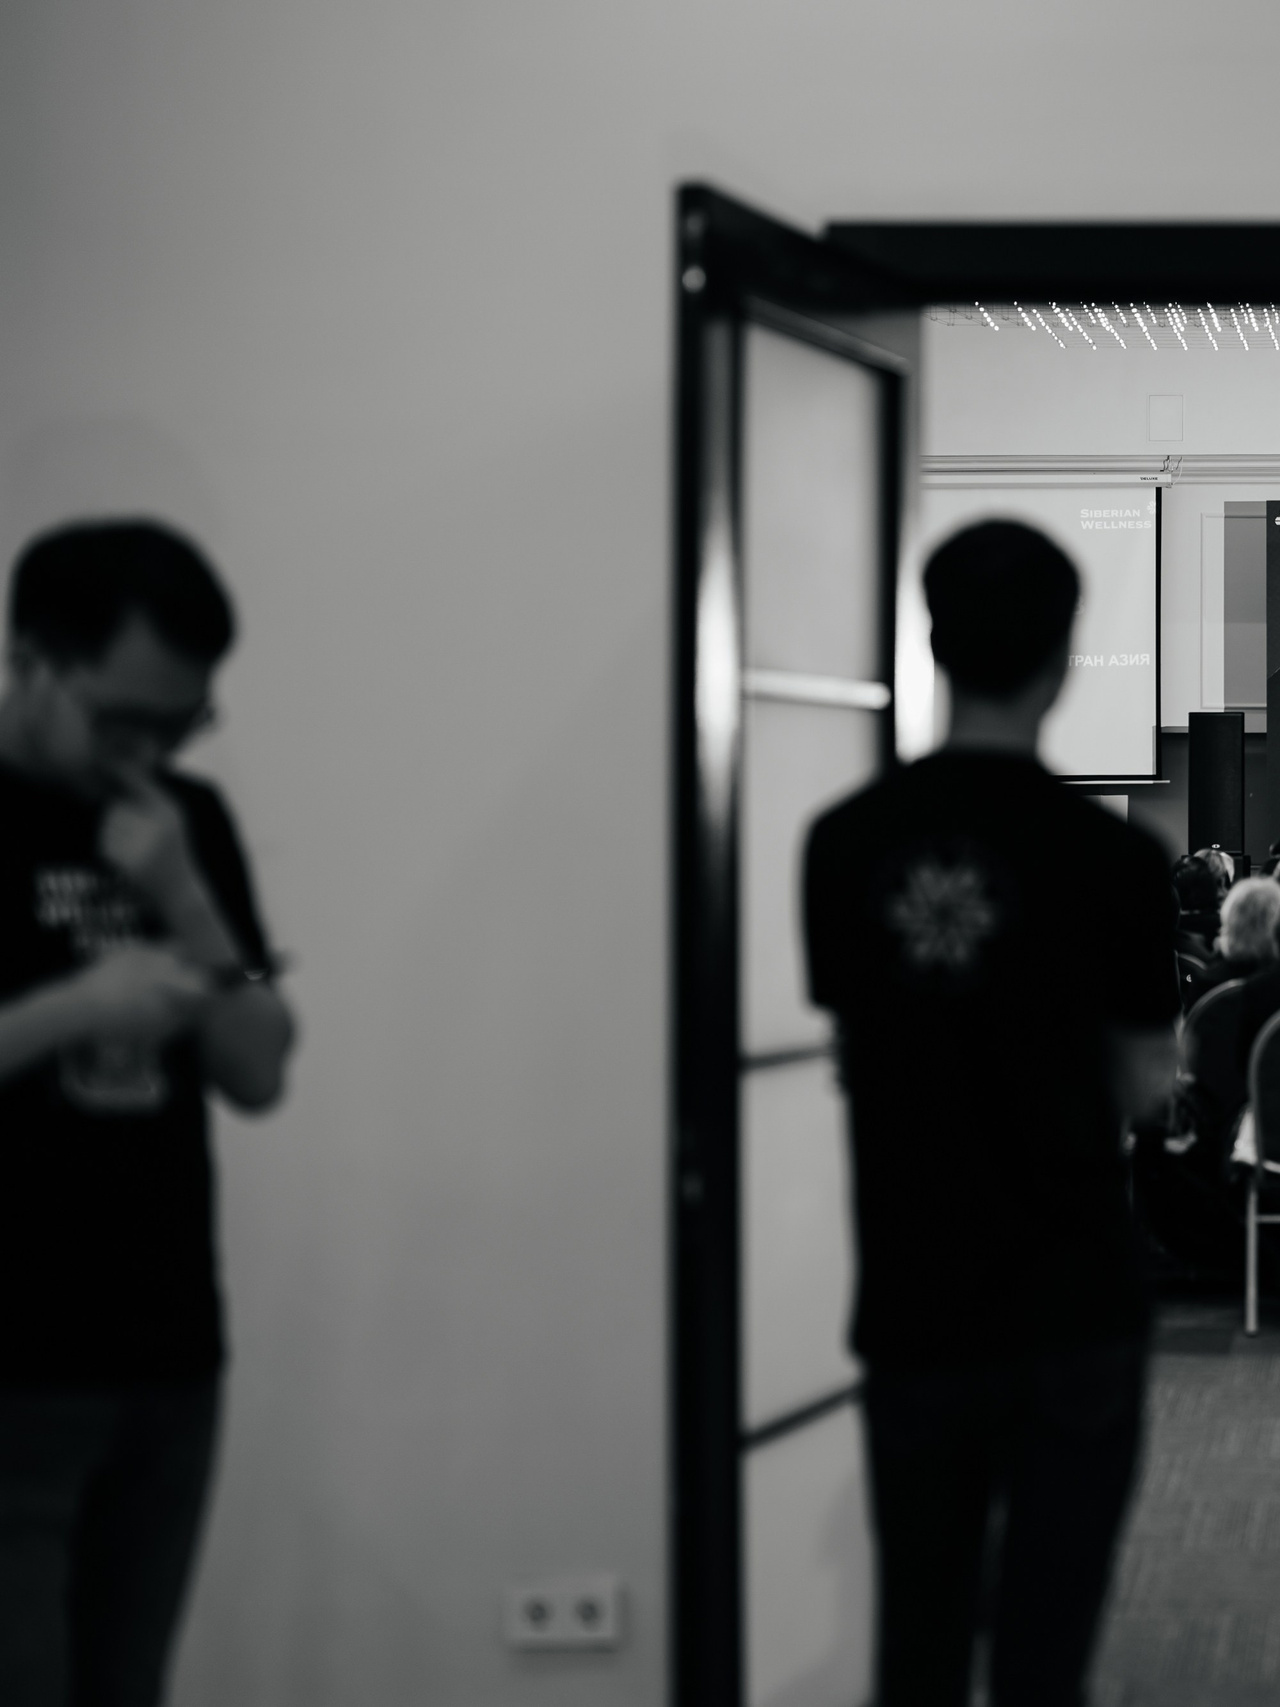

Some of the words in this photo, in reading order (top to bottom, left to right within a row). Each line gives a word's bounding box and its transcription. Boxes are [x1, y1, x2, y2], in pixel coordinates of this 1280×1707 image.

[1080, 509, 1141, 518] SIBERIAN
[1080, 520, 1152, 530] WELLNESS
[1108, 653, 1150, 667] АЗИЯ
